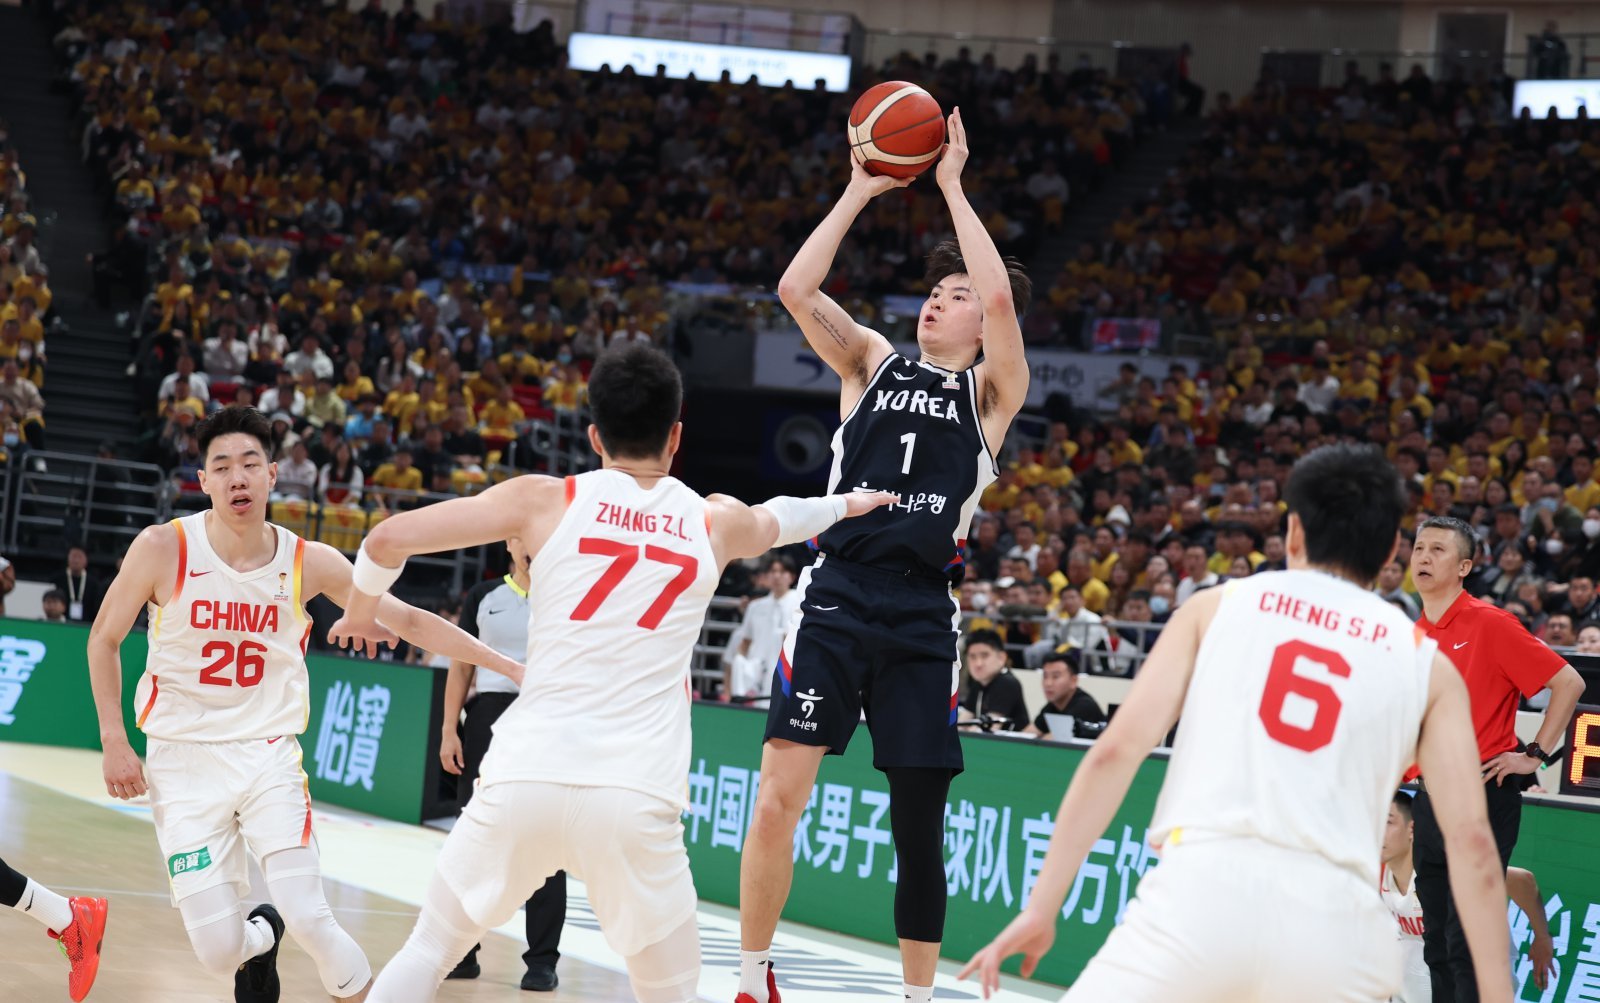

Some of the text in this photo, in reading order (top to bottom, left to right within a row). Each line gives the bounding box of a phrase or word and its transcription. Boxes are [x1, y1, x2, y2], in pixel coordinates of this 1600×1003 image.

[872, 389, 961, 424] KOREA
[900, 432, 917, 475] 1
[595, 502, 692, 541] ZHANG Z.L.
[880, 489, 947, 514] 나은행
[569, 537, 699, 630] 77
[190, 599, 278, 633] CHINA
[1258, 591, 1391, 651] CHENG S.P.
[199, 640, 268, 687] 26
[1258, 639, 1352, 753] 6
[314, 680, 391, 791] 怡寶
